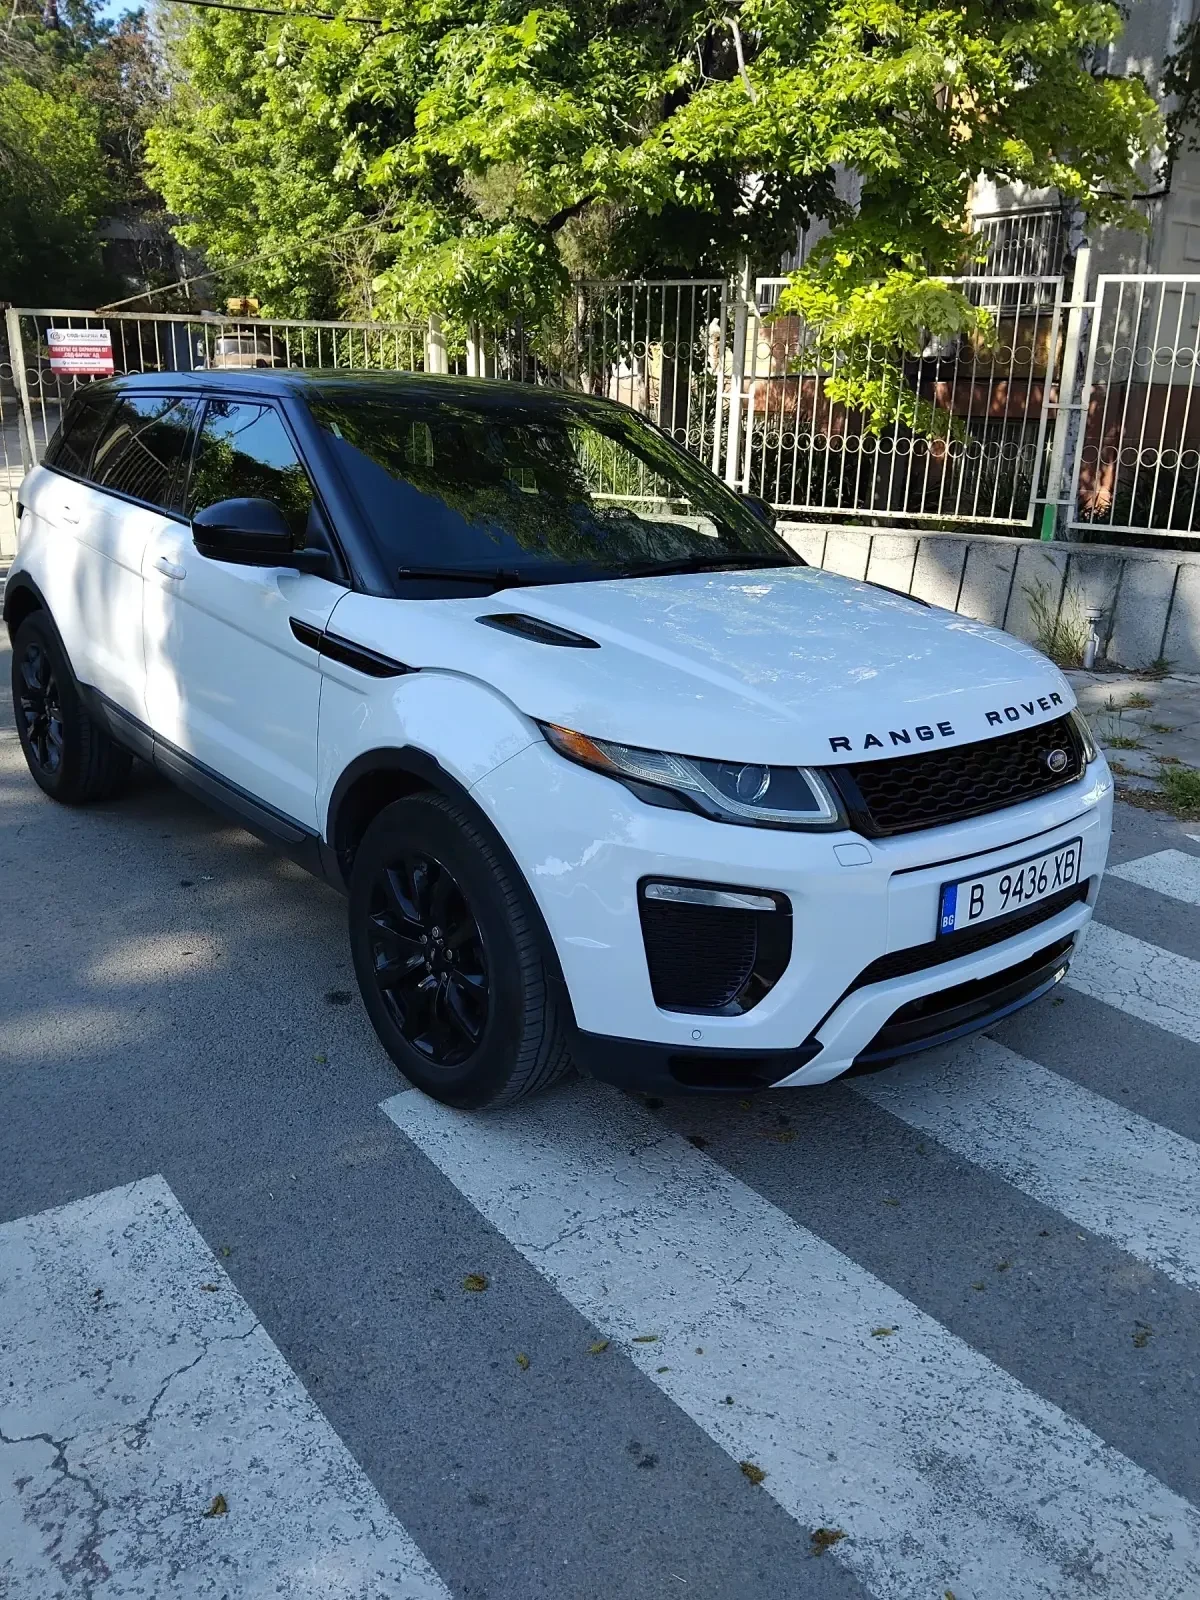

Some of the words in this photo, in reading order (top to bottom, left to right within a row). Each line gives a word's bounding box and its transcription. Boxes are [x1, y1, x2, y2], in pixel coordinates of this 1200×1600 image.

[828, 721, 955, 752] RANGE
[984, 692, 1063, 726] ROVER
[968, 883, 984, 920] B
[999, 861, 1048, 910] 9436
[1052, 849, 1075, 889] XB
[942, 914, 955, 927] BG
